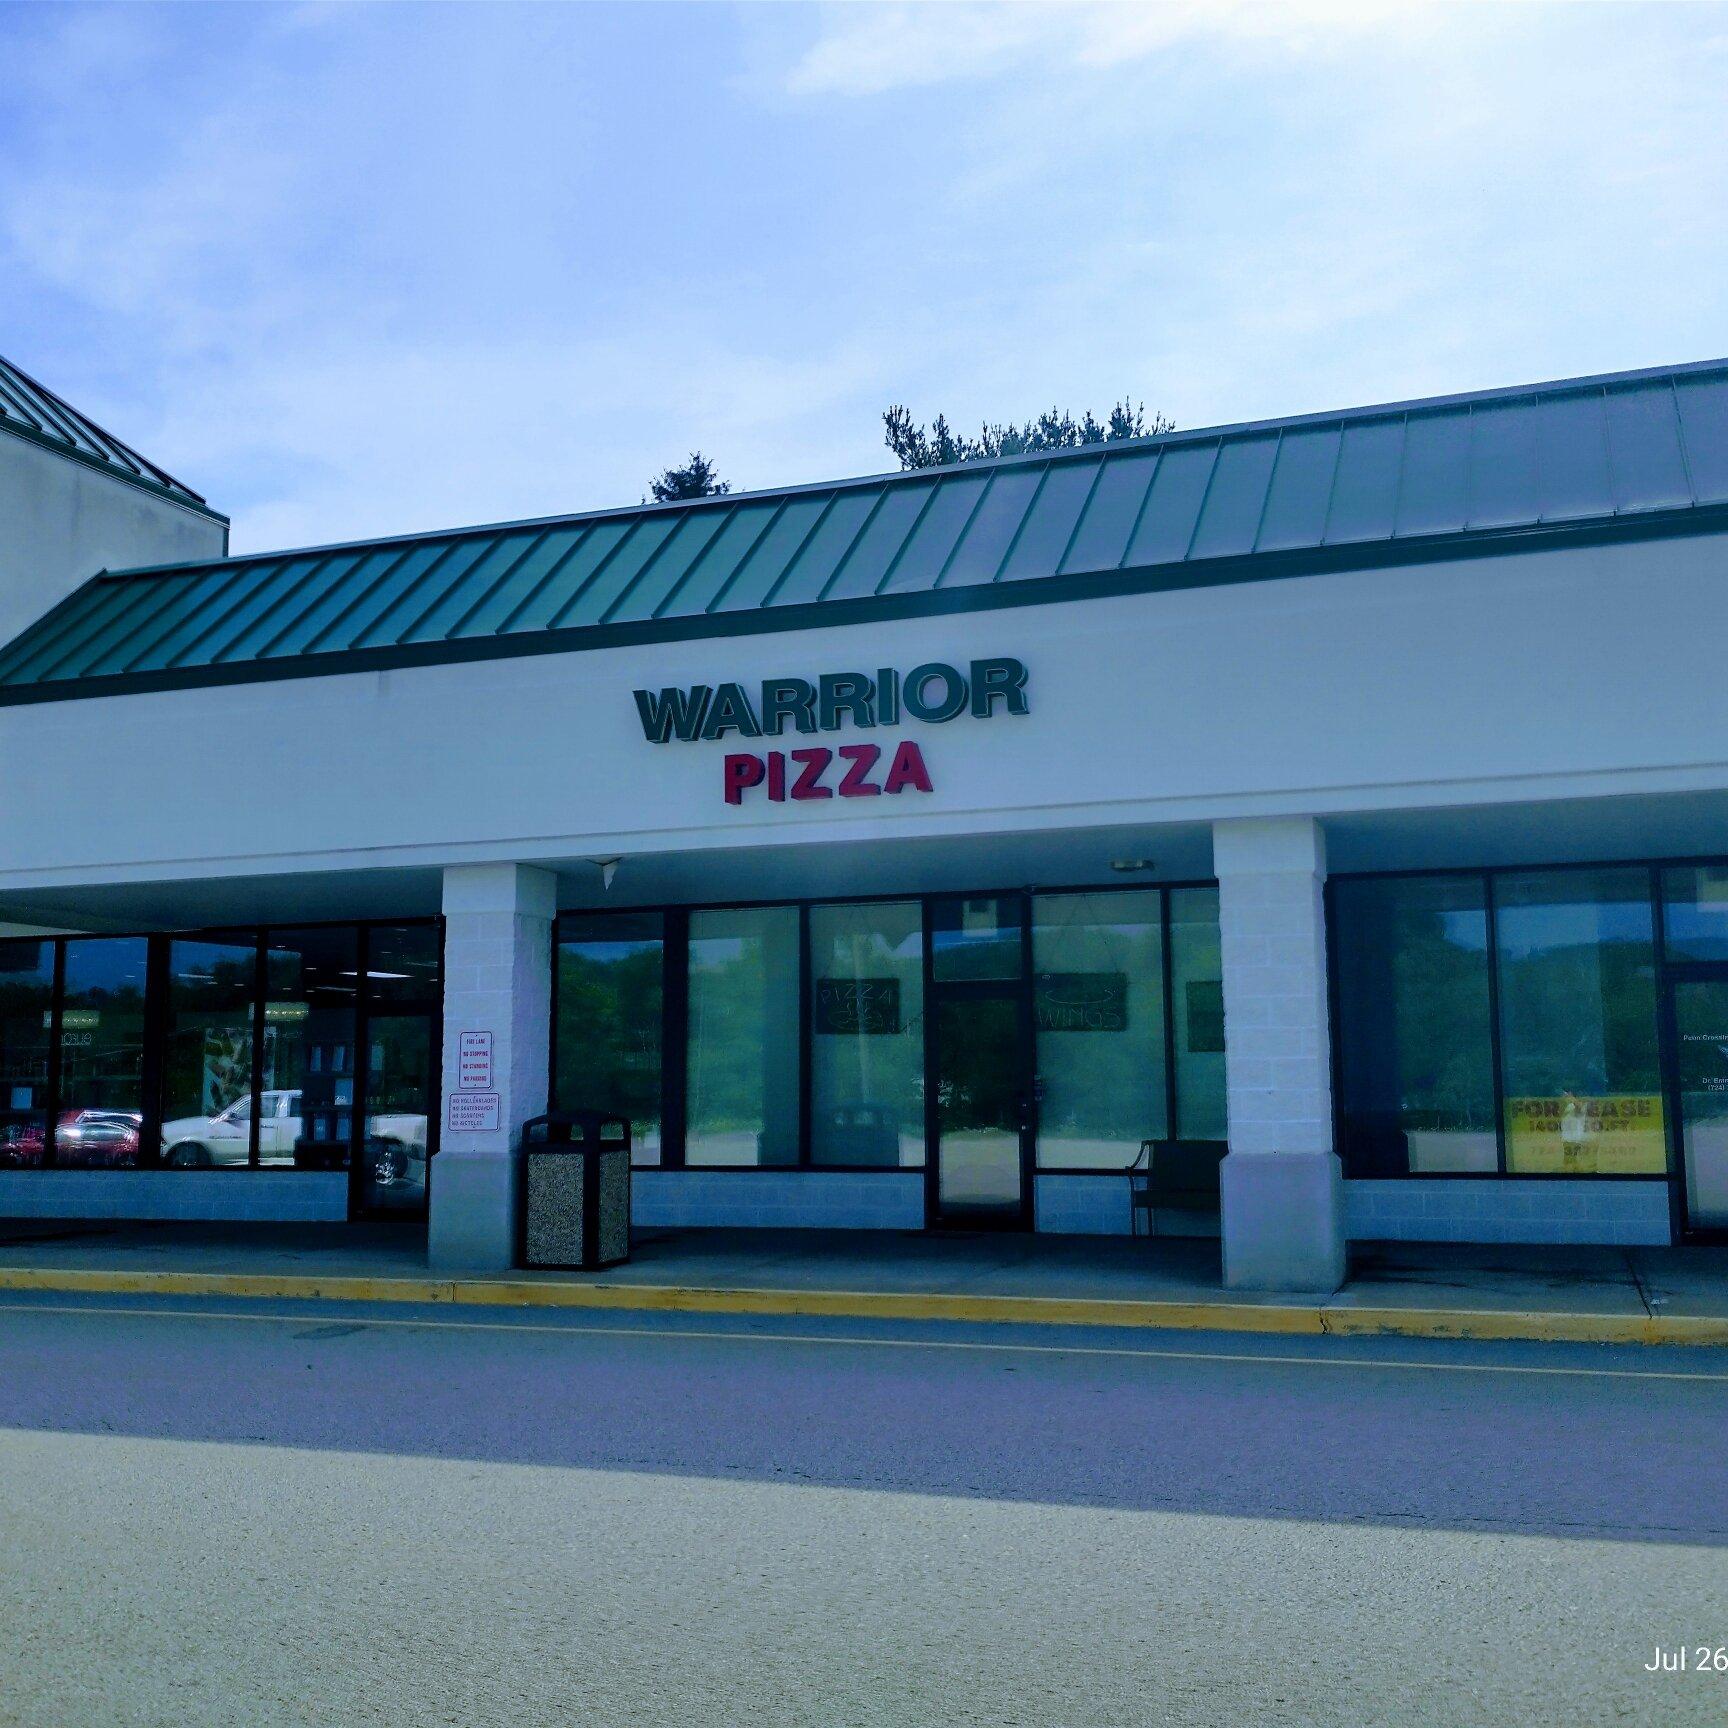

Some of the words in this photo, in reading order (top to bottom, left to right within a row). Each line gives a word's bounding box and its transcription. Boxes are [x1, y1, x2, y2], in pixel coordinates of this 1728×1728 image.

[632, 657, 1031, 745] WARRIOR
[724, 740, 935, 806] PIZZA
[820, 983, 891, 1005] PIZZA
[1511, 1100, 1561, 1118] FOR
